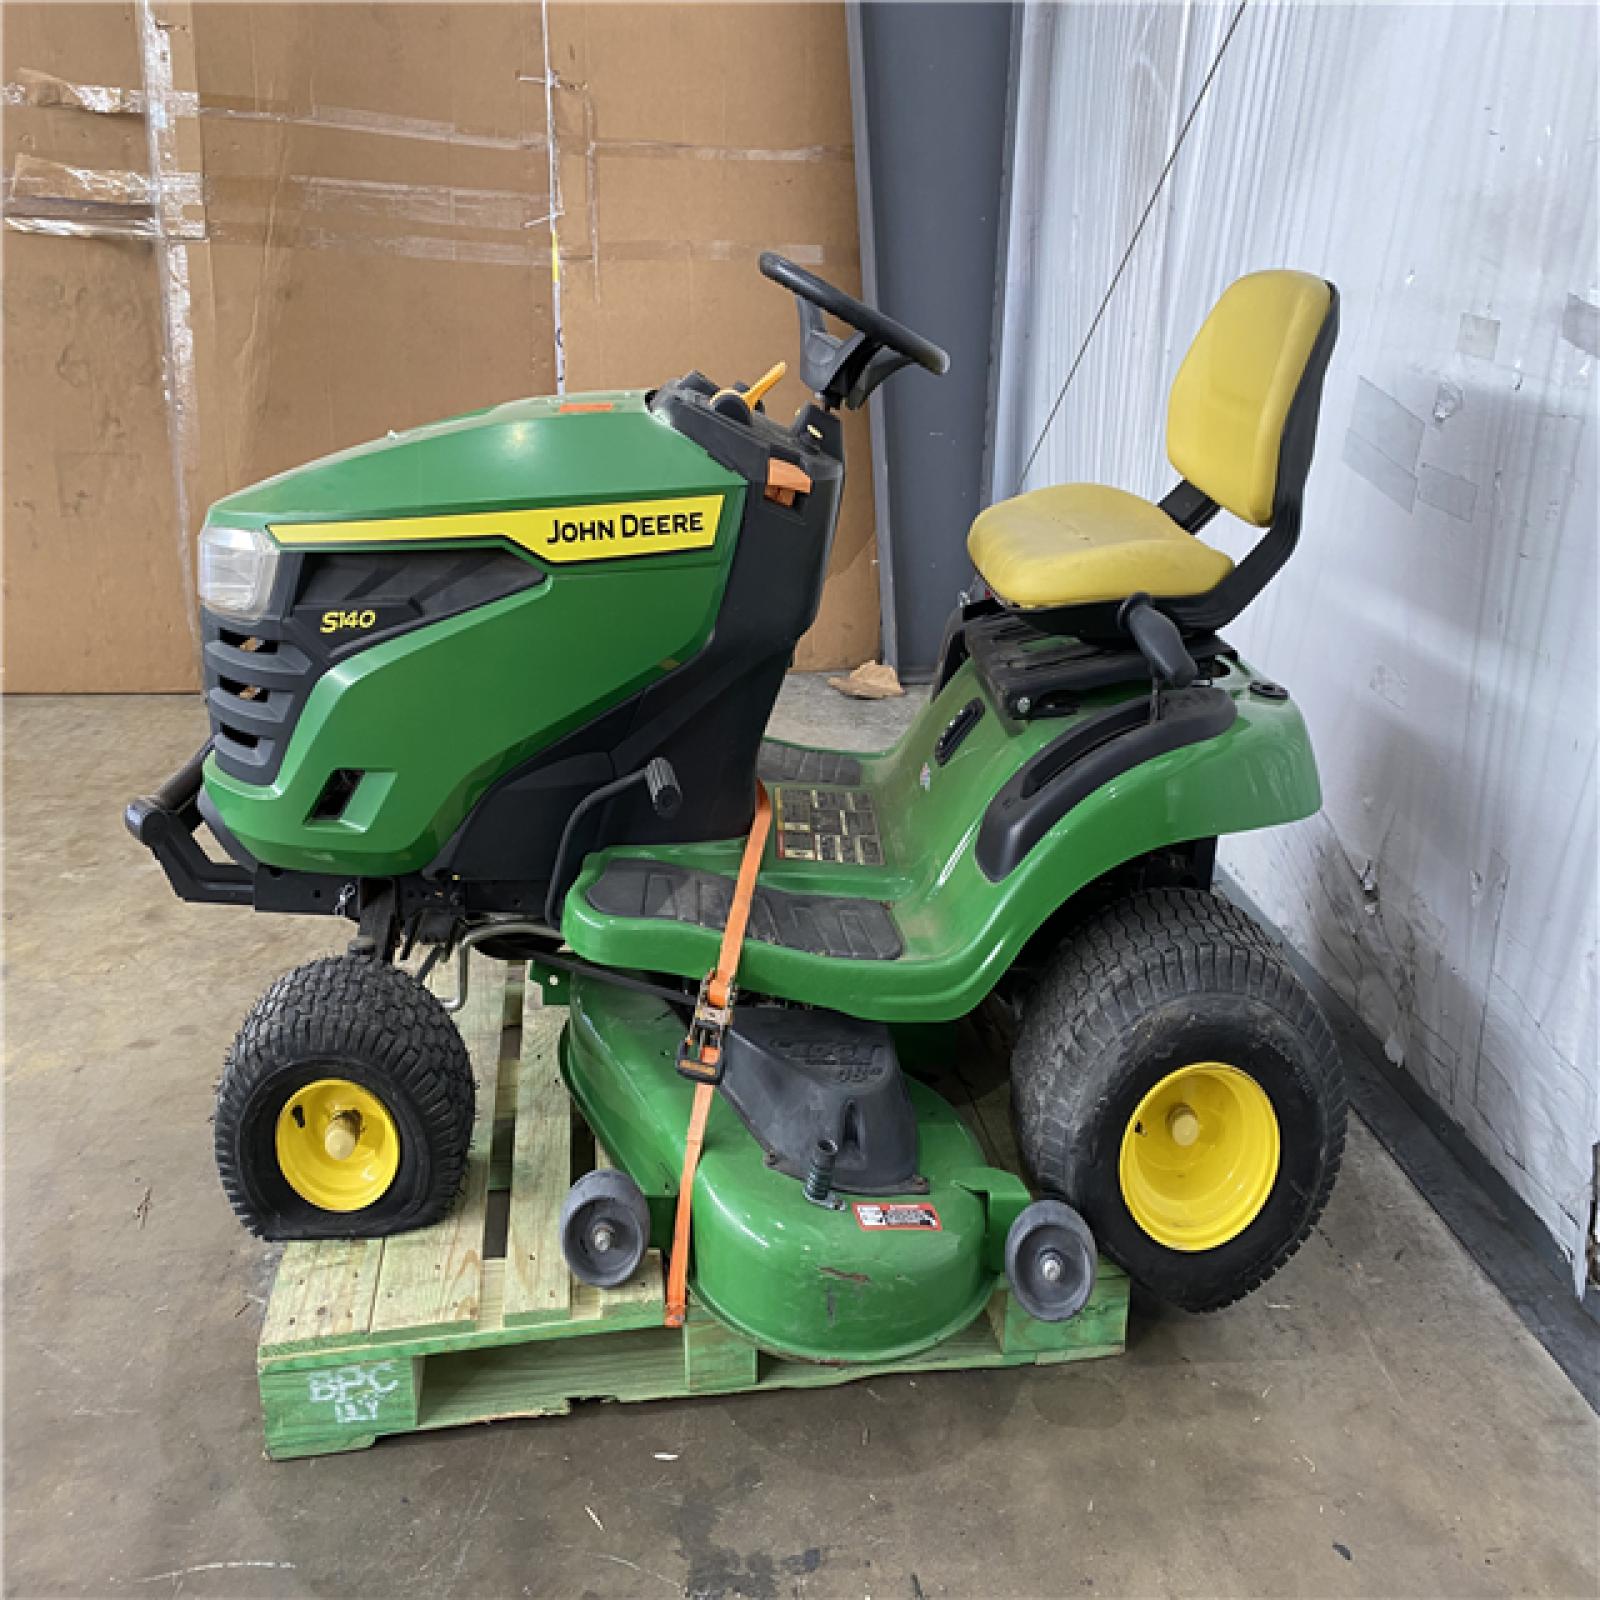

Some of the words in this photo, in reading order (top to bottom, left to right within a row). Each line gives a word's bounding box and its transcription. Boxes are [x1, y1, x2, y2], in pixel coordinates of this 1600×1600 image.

[547, 519, 615, 545] JOHN
[620, 512, 704, 538] DEERE
[320, 610, 376, 633] S140
[308, 1361, 399, 1402] BPC
